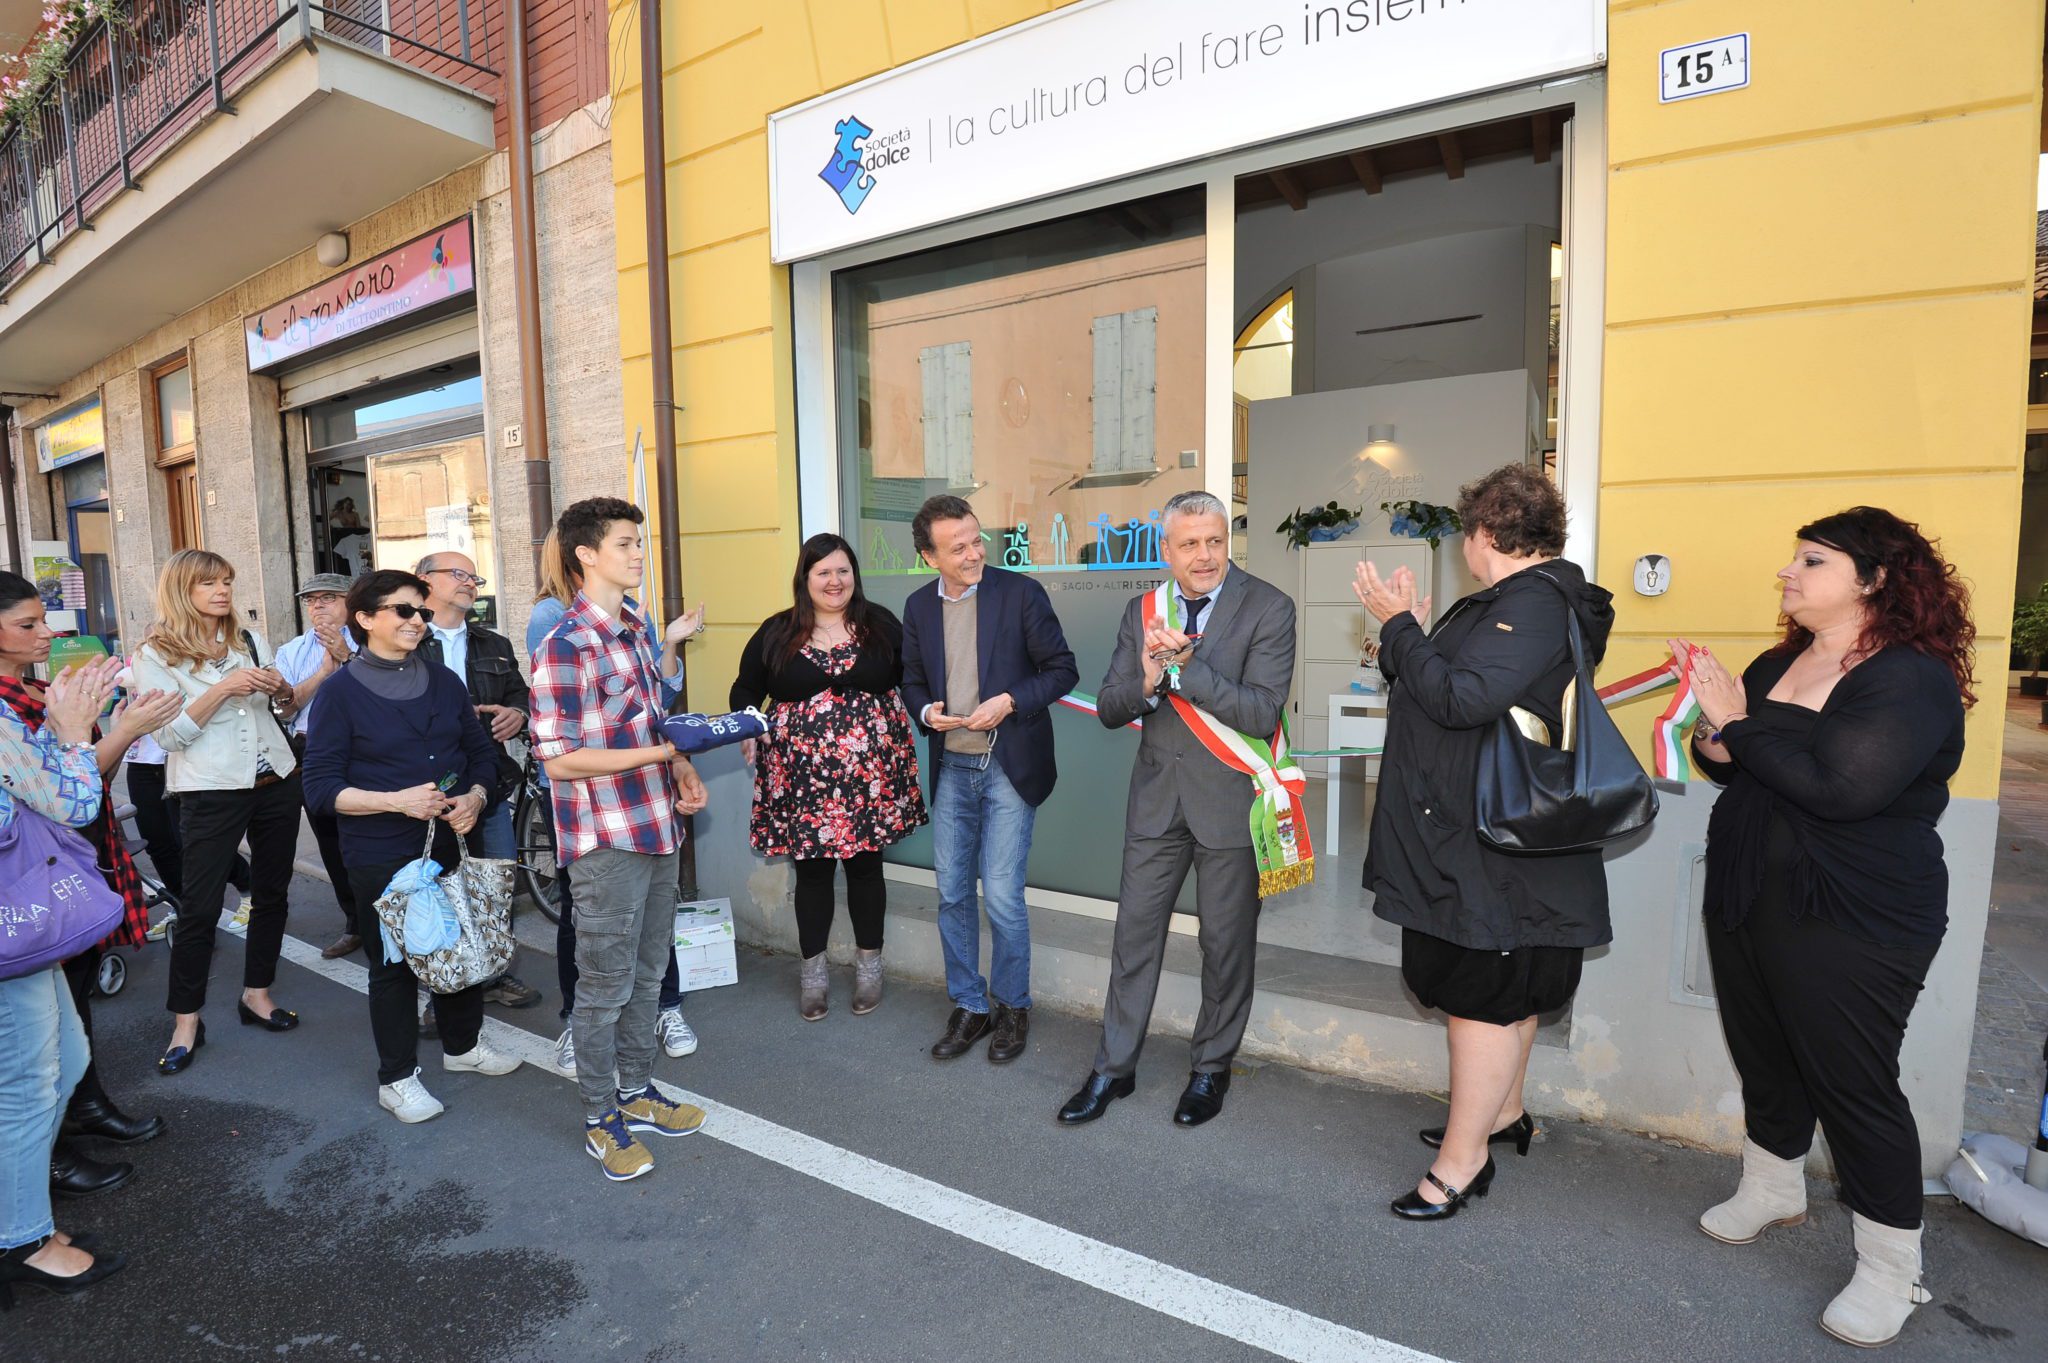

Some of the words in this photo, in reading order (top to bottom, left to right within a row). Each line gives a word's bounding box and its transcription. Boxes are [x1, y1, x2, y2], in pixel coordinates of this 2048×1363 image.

[948, 114, 975, 149] la
[988, 74, 1107, 136] cultura
[1124, 41, 1183, 95] del
[1201, 24, 1284, 74] fare
[865, 125, 912, 154] società
[865, 146, 911, 172] dolce
[282, 304, 302, 347] il
[306, 263, 395, 346] passero
[335, 321, 345, 334] DI
[346, 296, 412, 327] TUTTOINTIMO
[1381, 484, 1424, 499] dolce
[1050, 581, 1094, 591] DISAGIO
[1103, 581, 1133, 591] ALTRI
[1136, 580, 1166, 591] SETT
